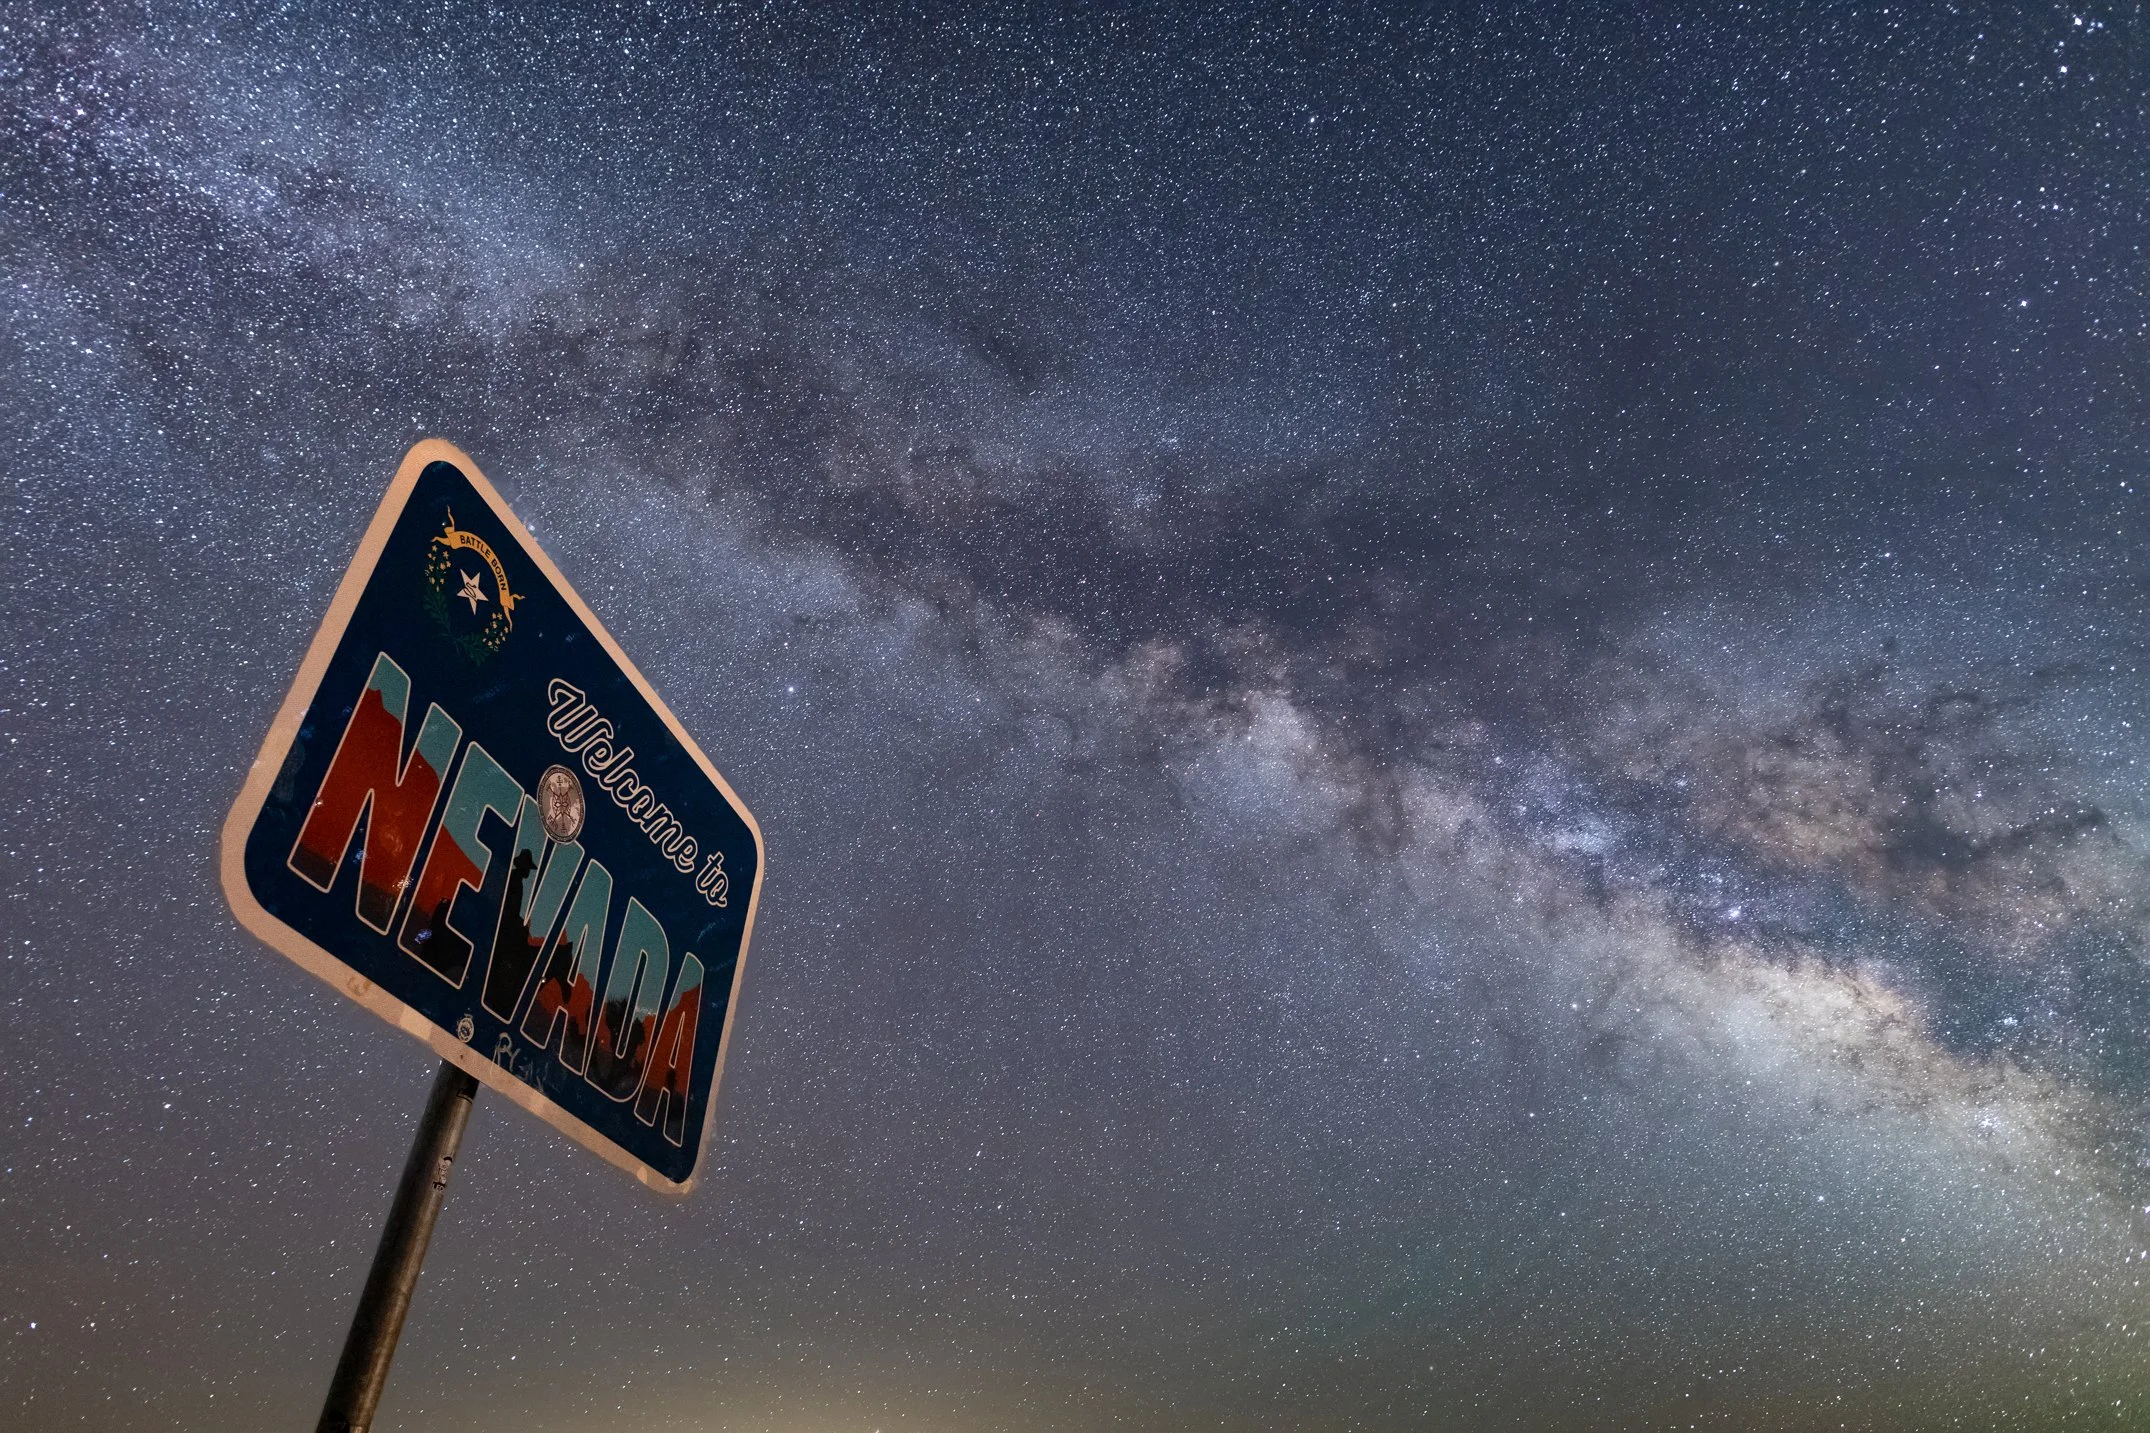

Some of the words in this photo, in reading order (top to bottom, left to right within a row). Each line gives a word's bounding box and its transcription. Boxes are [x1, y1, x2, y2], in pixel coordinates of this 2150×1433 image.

[460, 534, 492, 559] BATTLE
[491, 558, 507, 591] BORN
[288, 651, 704, 1147] NEVADA
[547, 678, 698, 873] Welcome
[696, 851, 729, 907] to
